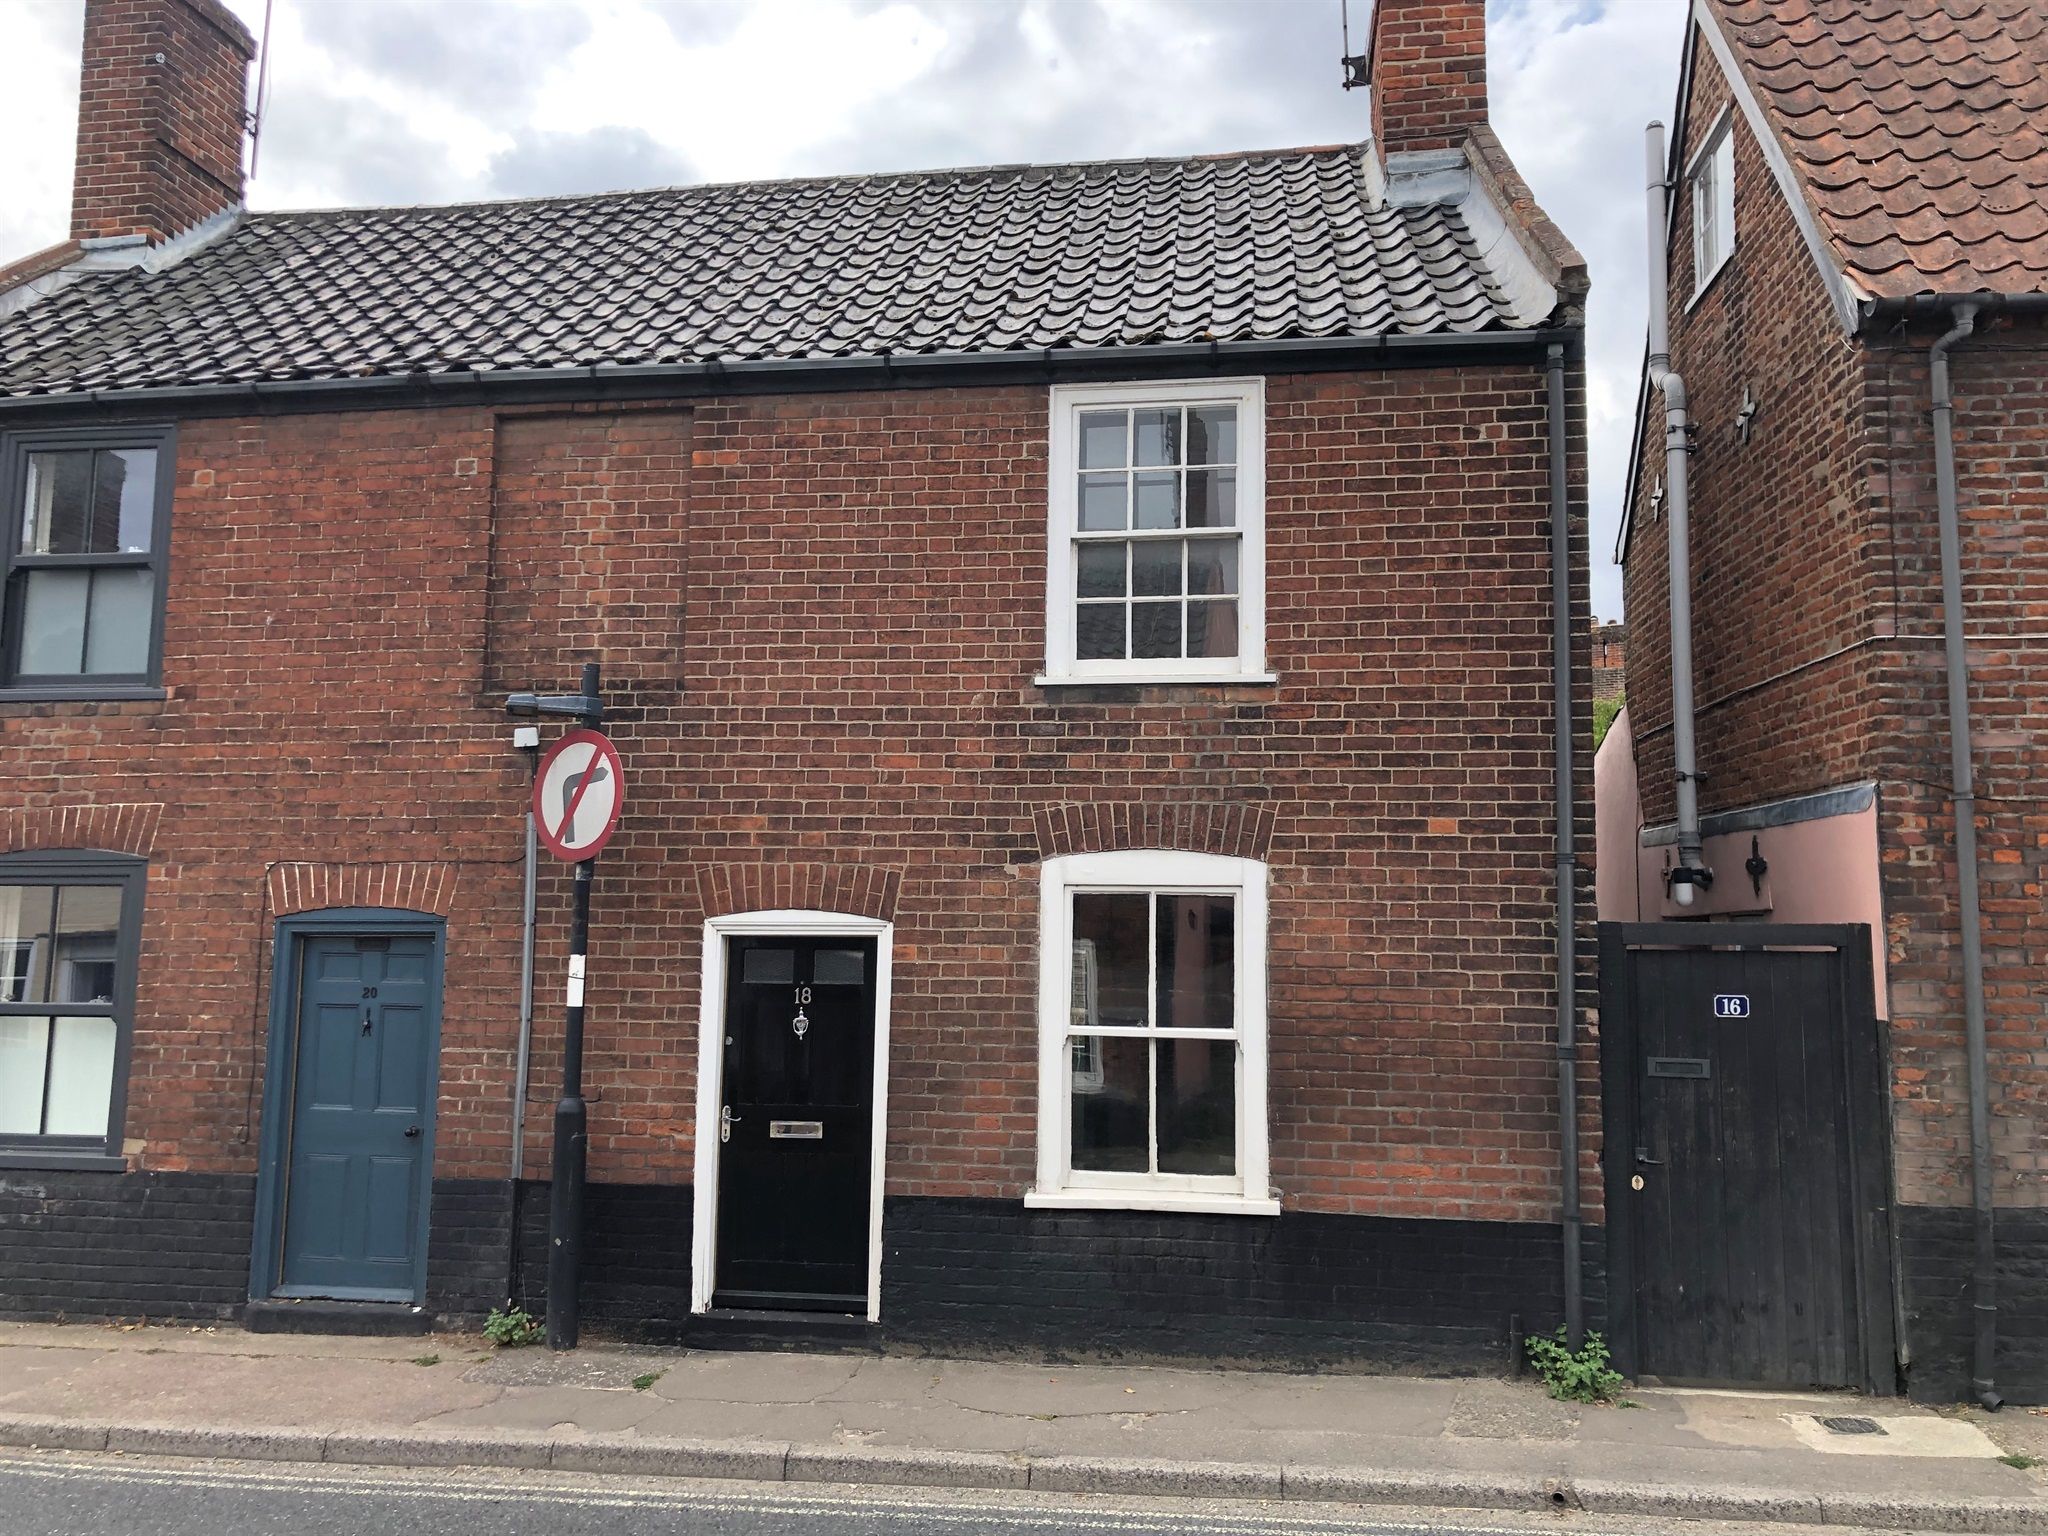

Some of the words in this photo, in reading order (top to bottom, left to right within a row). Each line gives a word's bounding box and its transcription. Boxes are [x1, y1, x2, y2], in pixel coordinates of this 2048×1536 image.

[362, 987, 378, 999] 20
[794, 987, 812, 1005] 18
[1722, 998, 1741, 1015] 16
